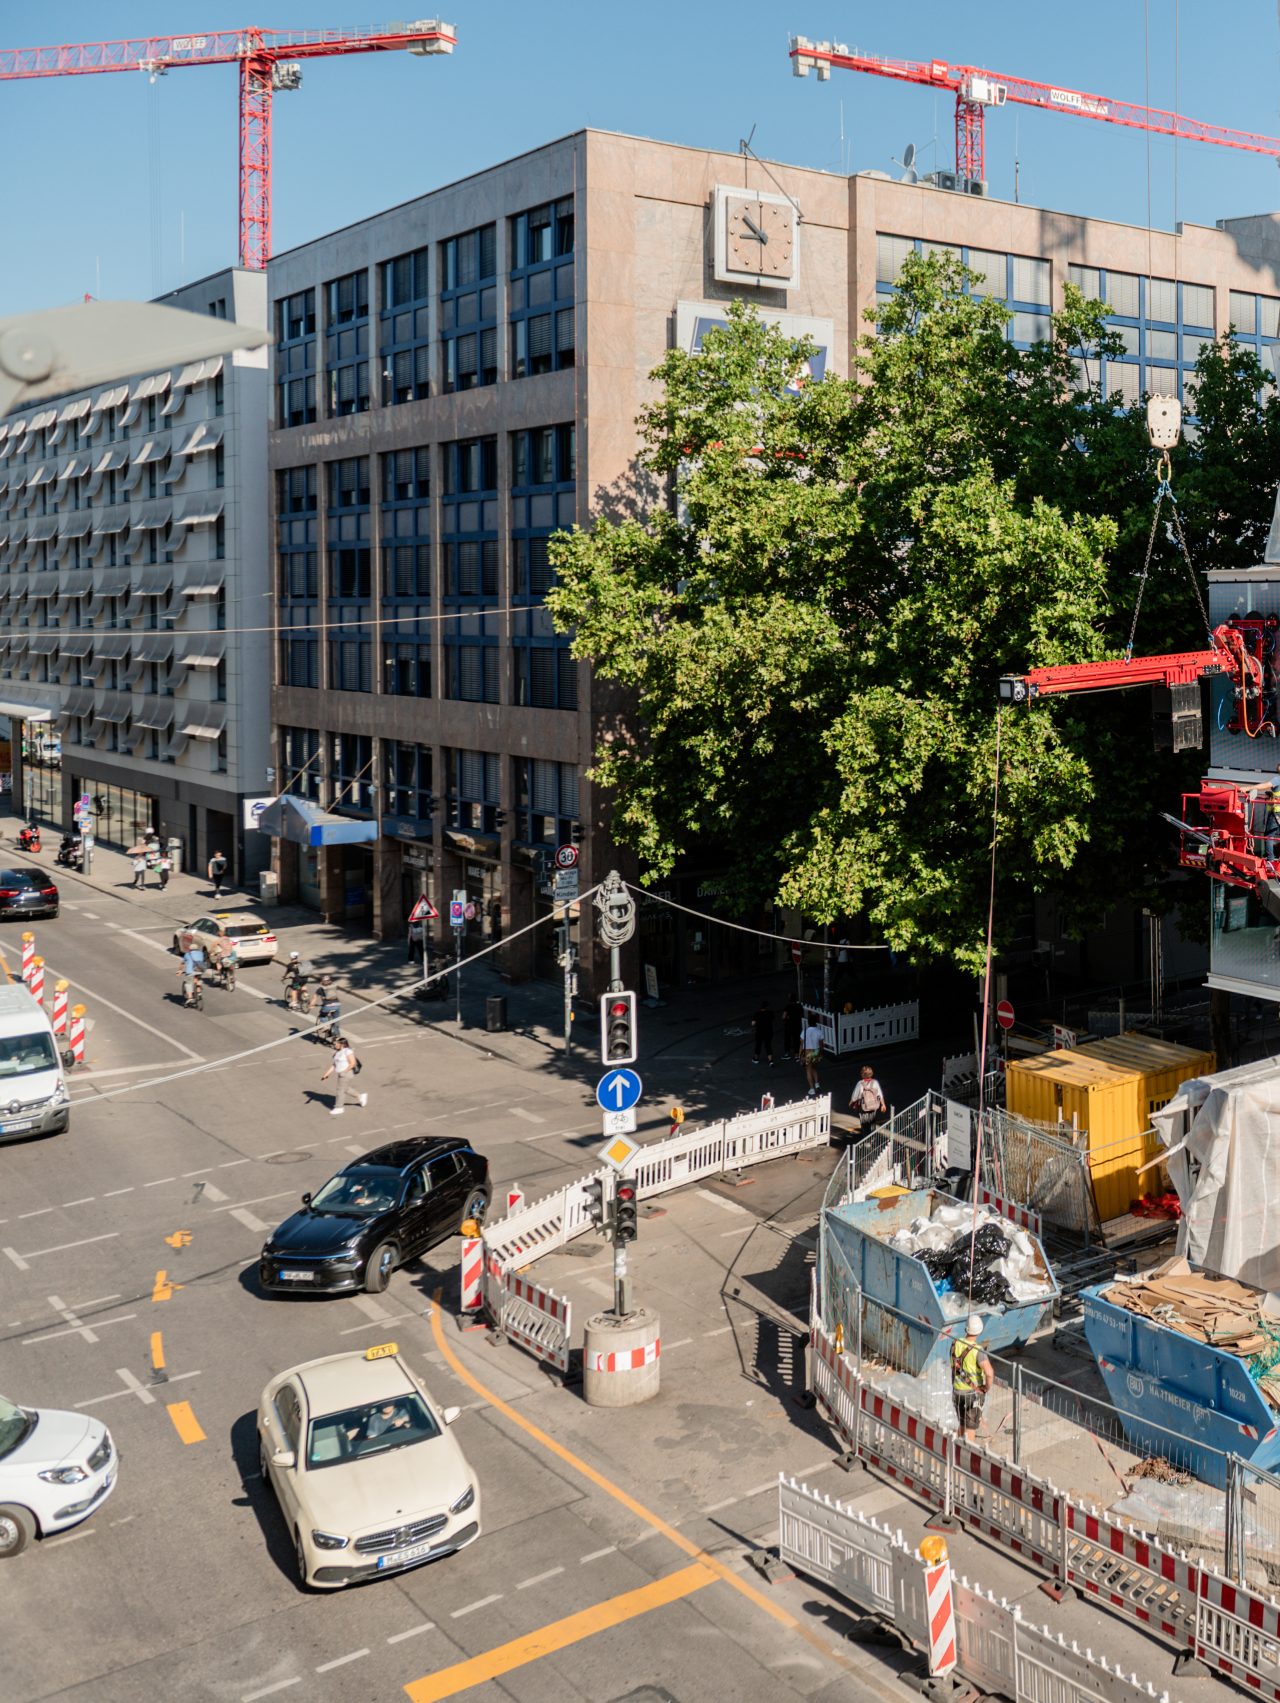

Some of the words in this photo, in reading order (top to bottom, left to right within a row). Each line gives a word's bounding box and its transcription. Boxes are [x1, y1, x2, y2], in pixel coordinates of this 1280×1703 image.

[1052, 91, 1080, 104] WOLFF
[560, 851, 574, 863] 30
[371, 1344, 394, 1358] TAXI
